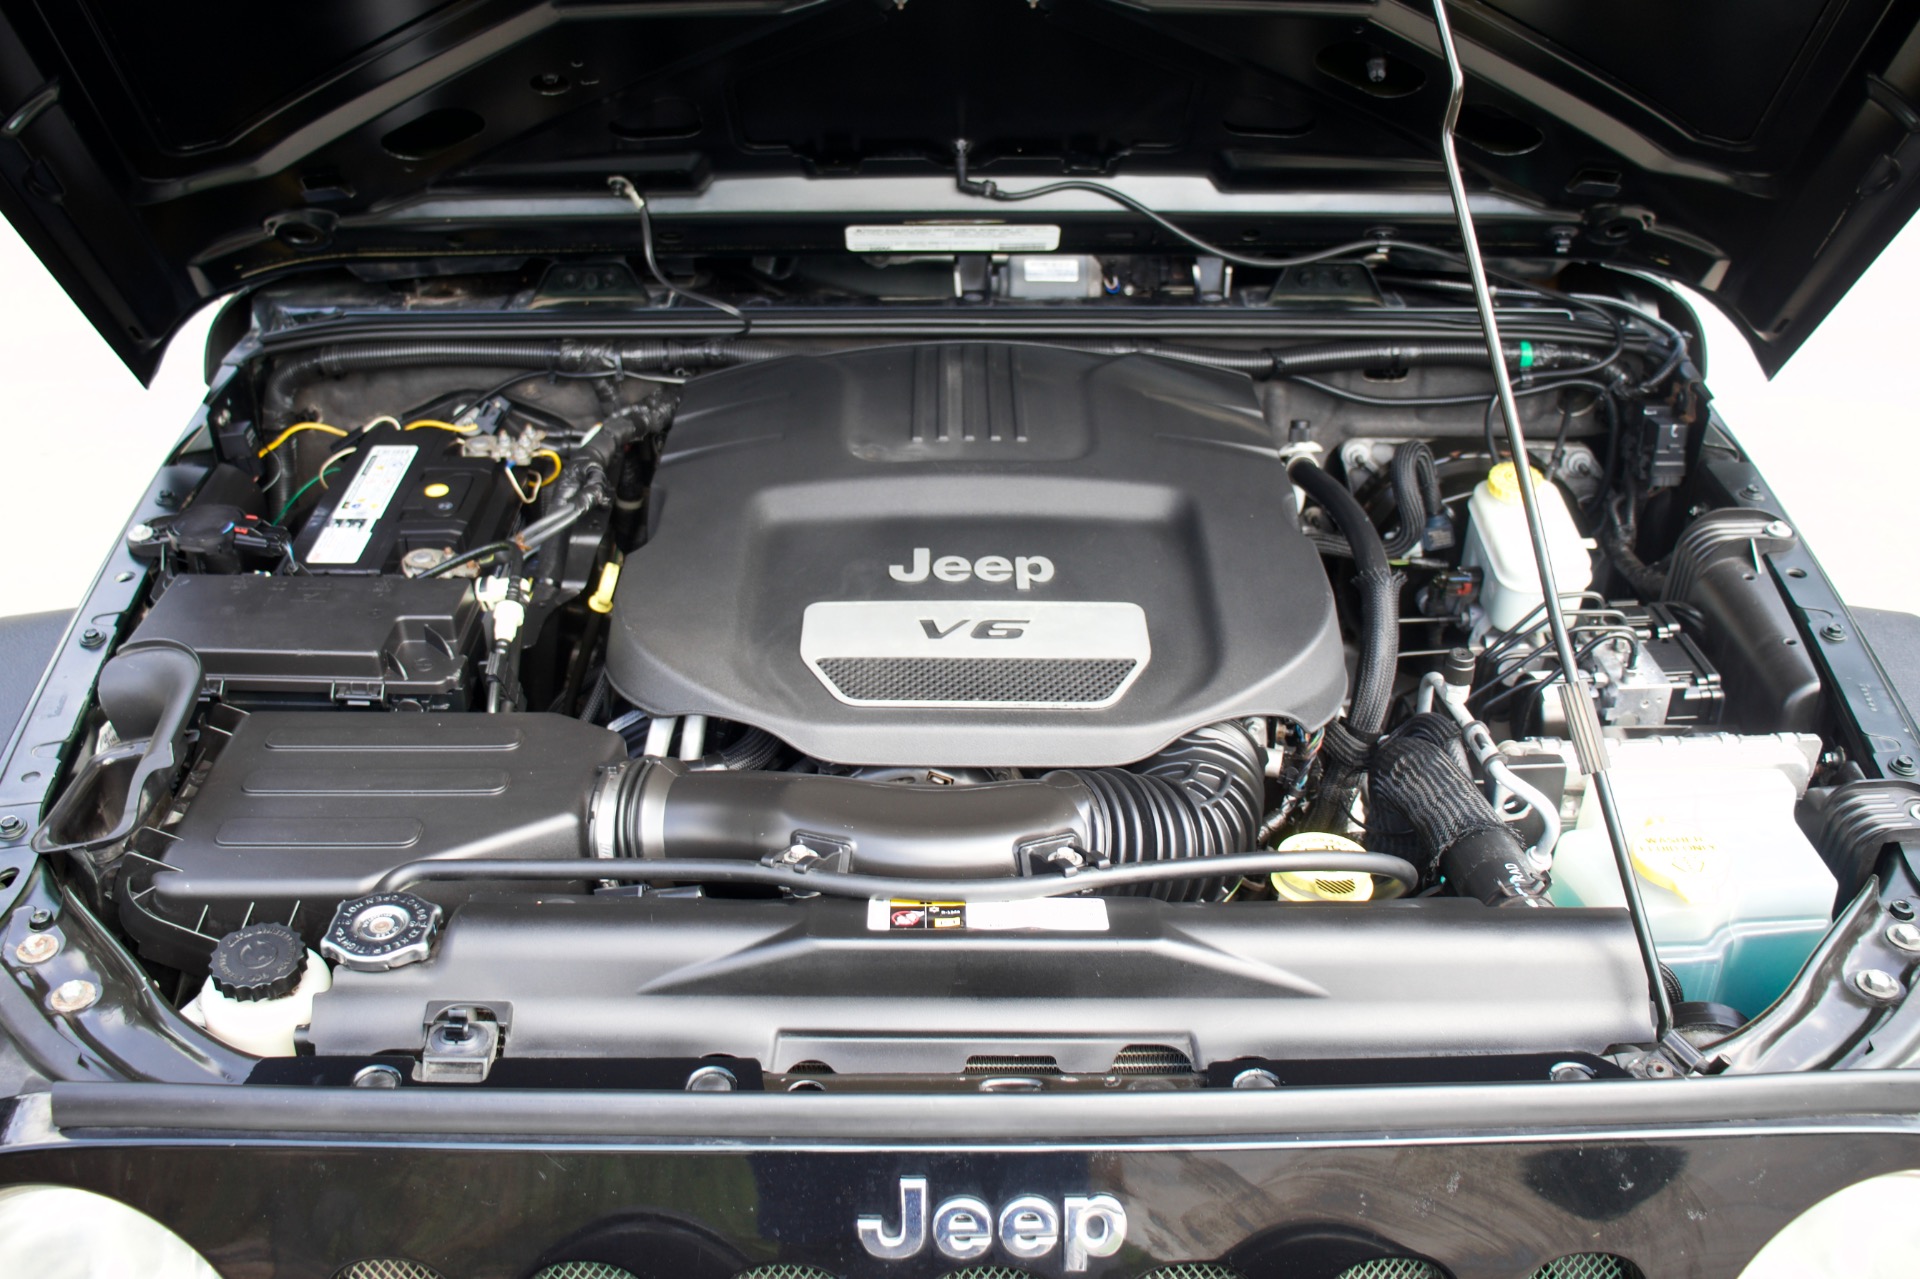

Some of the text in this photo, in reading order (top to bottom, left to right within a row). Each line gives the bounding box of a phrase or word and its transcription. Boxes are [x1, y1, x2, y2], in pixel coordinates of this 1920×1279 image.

[888, 547, 1055, 590] Jeep
[919, 619, 1031, 640] V6
[857, 1175, 1128, 1272] Jeep
